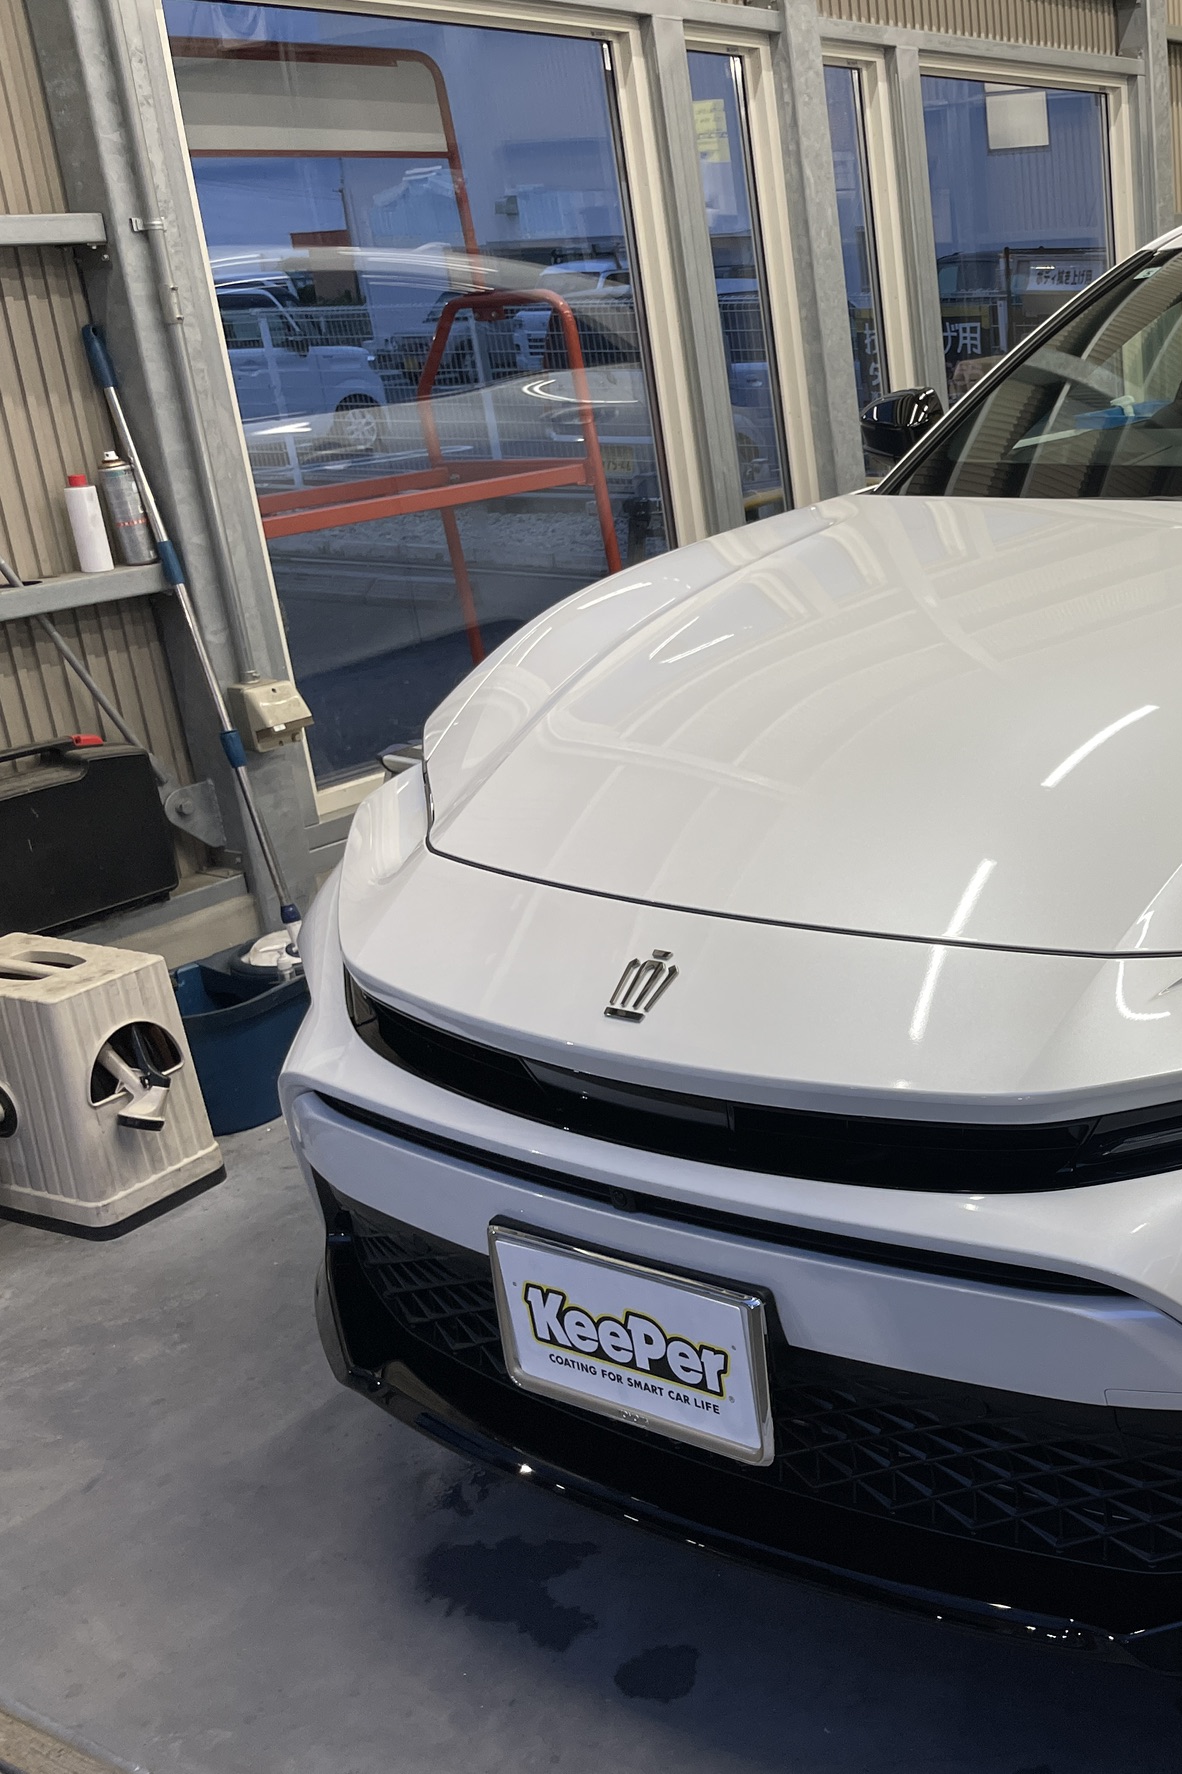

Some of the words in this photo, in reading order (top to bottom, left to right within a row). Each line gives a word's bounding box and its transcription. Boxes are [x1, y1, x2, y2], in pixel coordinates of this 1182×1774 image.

[523, 1282, 730, 1398] KeePer
[549, 1353, 598, 1376] COATING
[601, 1369, 623, 1385] FOR
[627, 1377, 664, 1397] SMART
[668, 1390, 691, 1405] CAR
[694, 1397, 720, 1415] LIFE
